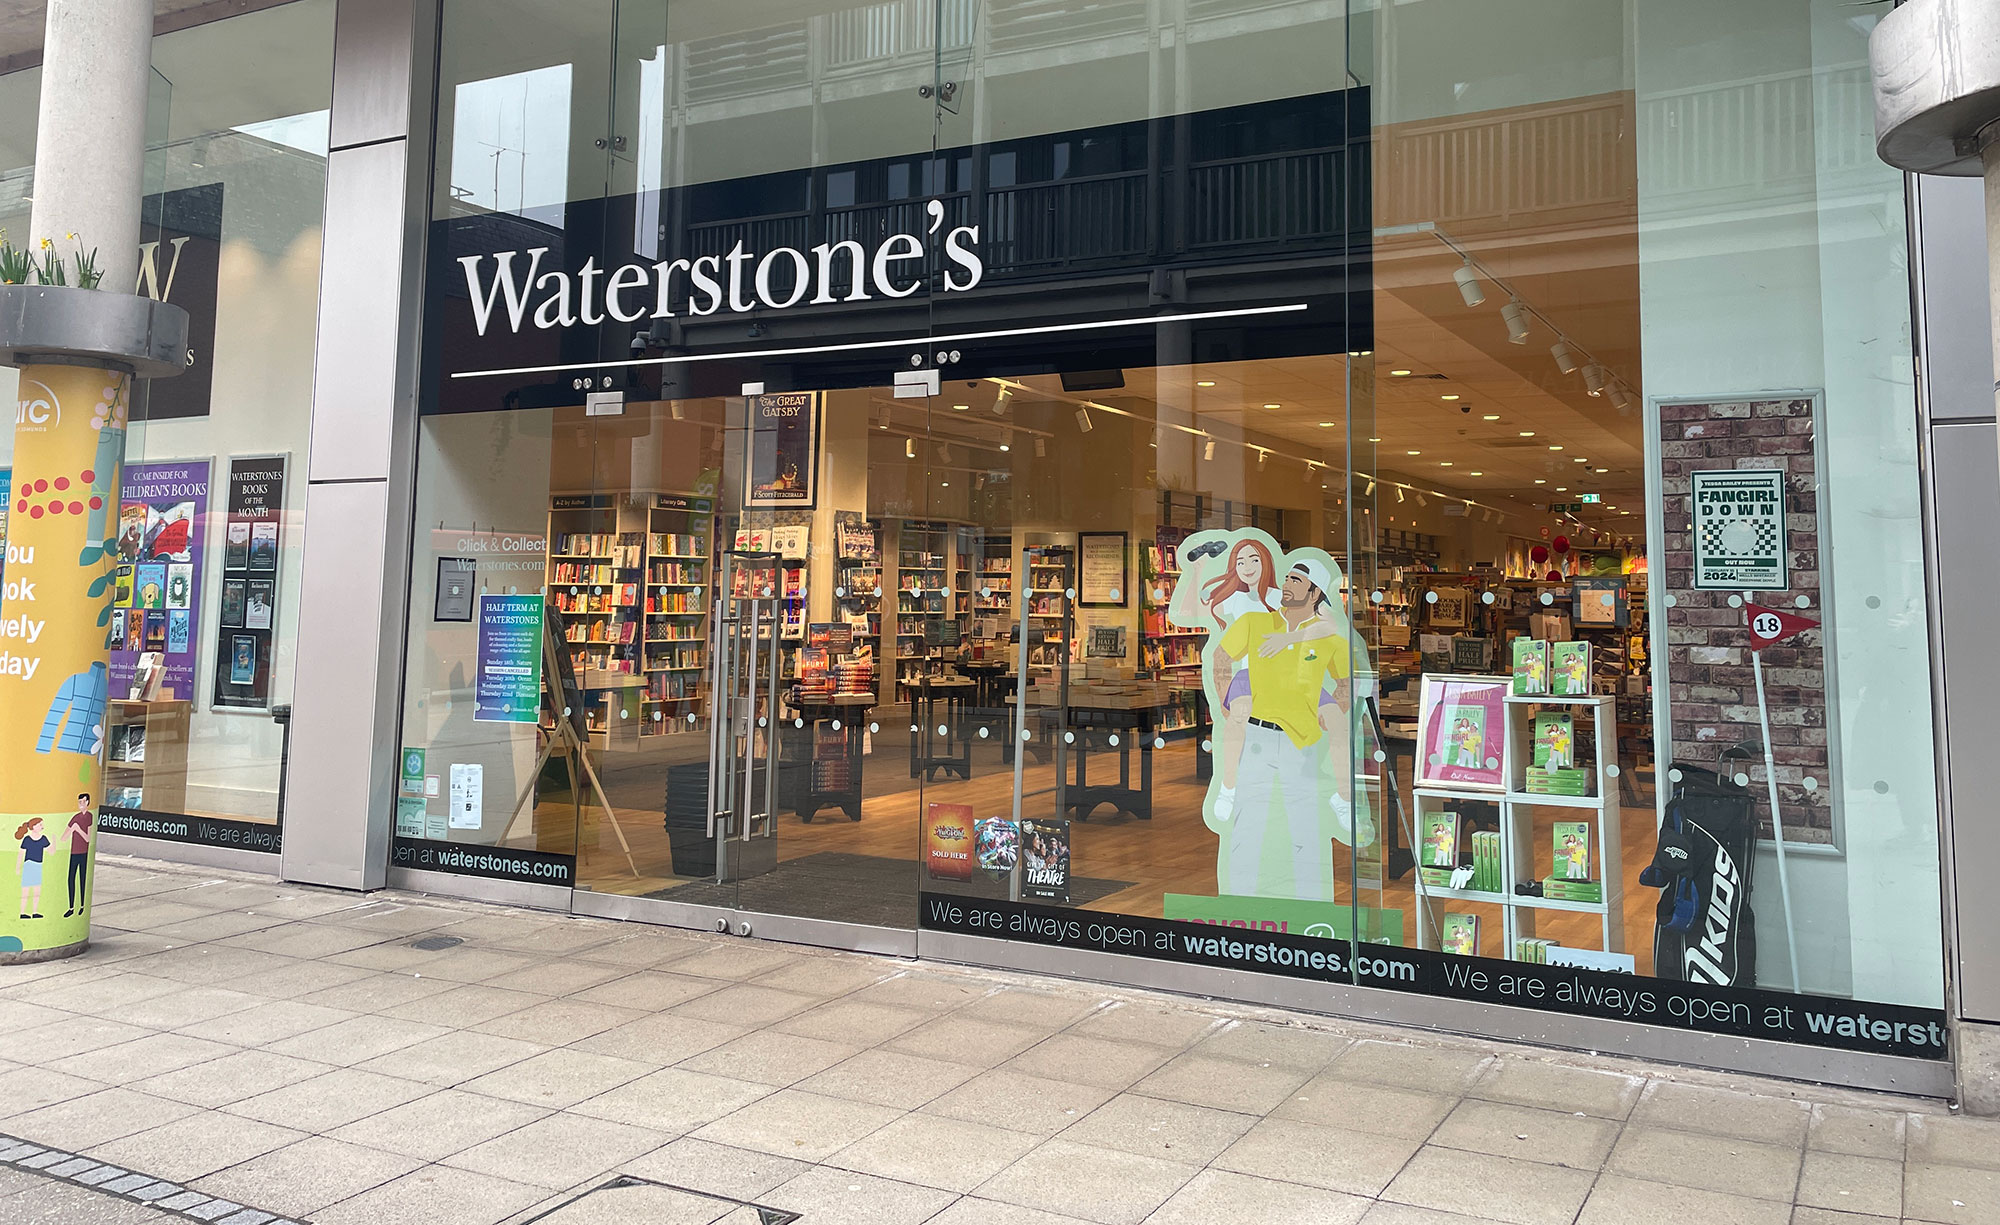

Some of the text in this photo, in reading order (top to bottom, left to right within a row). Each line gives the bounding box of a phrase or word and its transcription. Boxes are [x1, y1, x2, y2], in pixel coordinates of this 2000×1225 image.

[457, 199, 983, 337] Waterstone's
[759, 396, 807, 407] The GREAT
[763, 407, 800, 417] GATSBY
[153, 471, 173, 480] INSIDE
[175, 470, 188, 479] FOR
[232, 471, 283, 481] WATERSTONES
[122, 482, 206, 498] HILDREN'S BOOKS
[242, 484, 268, 494] BOOKS
[1698, 490, 1779, 502] FANGIRL
[238, 507, 269, 518] MONTH
[1702, 504, 1774, 516] DOWN
[457, 537, 547, 552] Click & Collect
[457, 558, 545, 571] Waterstones.com
[1704, 572, 1736, 580] 2024
[486, 603, 539, 612] HALF TERM AT
[484, 615, 540, 625] WATERSTONES
[1756, 617, 1779, 633] 18
[199, 822, 216, 840] We
[220, 828, 240, 843] are
[243, 827, 282, 851] always
[931, 850, 968, 860] SOLD HERE
[394, 846, 569, 879] en at waterstones.com
[1026, 868, 1065, 886] THEATRE
[930, 900, 963, 924] We
[969, 909, 1002, 929] are
[1009, 910, 1081, 942] always
[1088, 923, 1146, 949] open
[1154, 930, 1176, 951] at
[1184, 934, 1416, 982] waterstones.com
[1443, 962, 1488, 990] We
[1499, 974, 1546, 998] are
[1556, 976, 1657, 1016] always
[1667, 995, 1750, 1026] open
[1763, 1005, 1795, 1030] at
